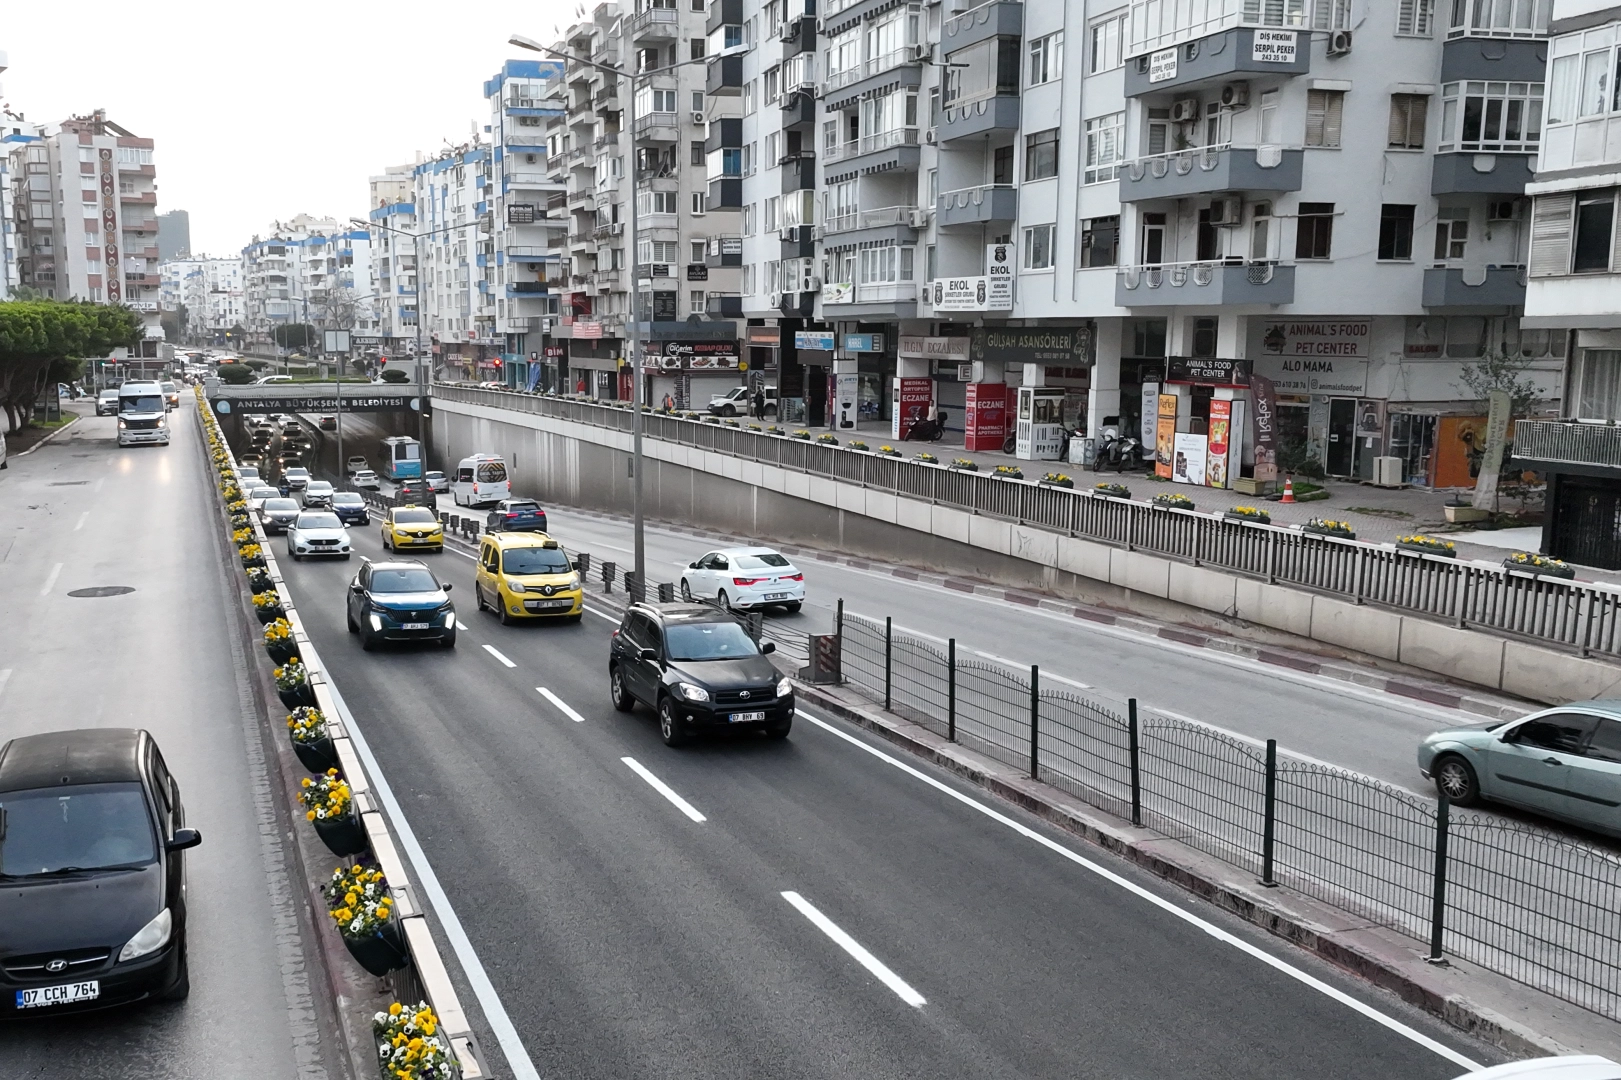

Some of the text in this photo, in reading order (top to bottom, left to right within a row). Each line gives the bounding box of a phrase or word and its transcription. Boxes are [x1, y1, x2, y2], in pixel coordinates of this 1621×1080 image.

[1260, 32, 1292, 42] DİŞ HEKİMİ
[1255, 42, 1295, 54] SERPİL PEKER
[990, 265, 1010, 275] EKOL
[949, 280, 969, 291] EKOL
[1289, 324, 1367, 336] ANIMAL'S FOOD
[987, 332, 1072, 350] GÜLŞAH ASANSÖRLERİ
[547, 347, 563, 356] BİM
[1296, 342, 1357, 355] PET CENTER
[1186, 360, 1231, 369] ANIMAL'S FOOD
[1282, 360, 1333, 373] ALO MAMA
[1202, 369, 1225, 378] CENTER
[286, 398, 347, 408] BÜYÜKŞEHR
[352, 398, 404, 407] BELEDİYESİ
[902, 394, 929, 402] ECZANE
[977, 401, 1004, 409] ECZANE
[23, 982, 96, 1003] 07 CCH 764
